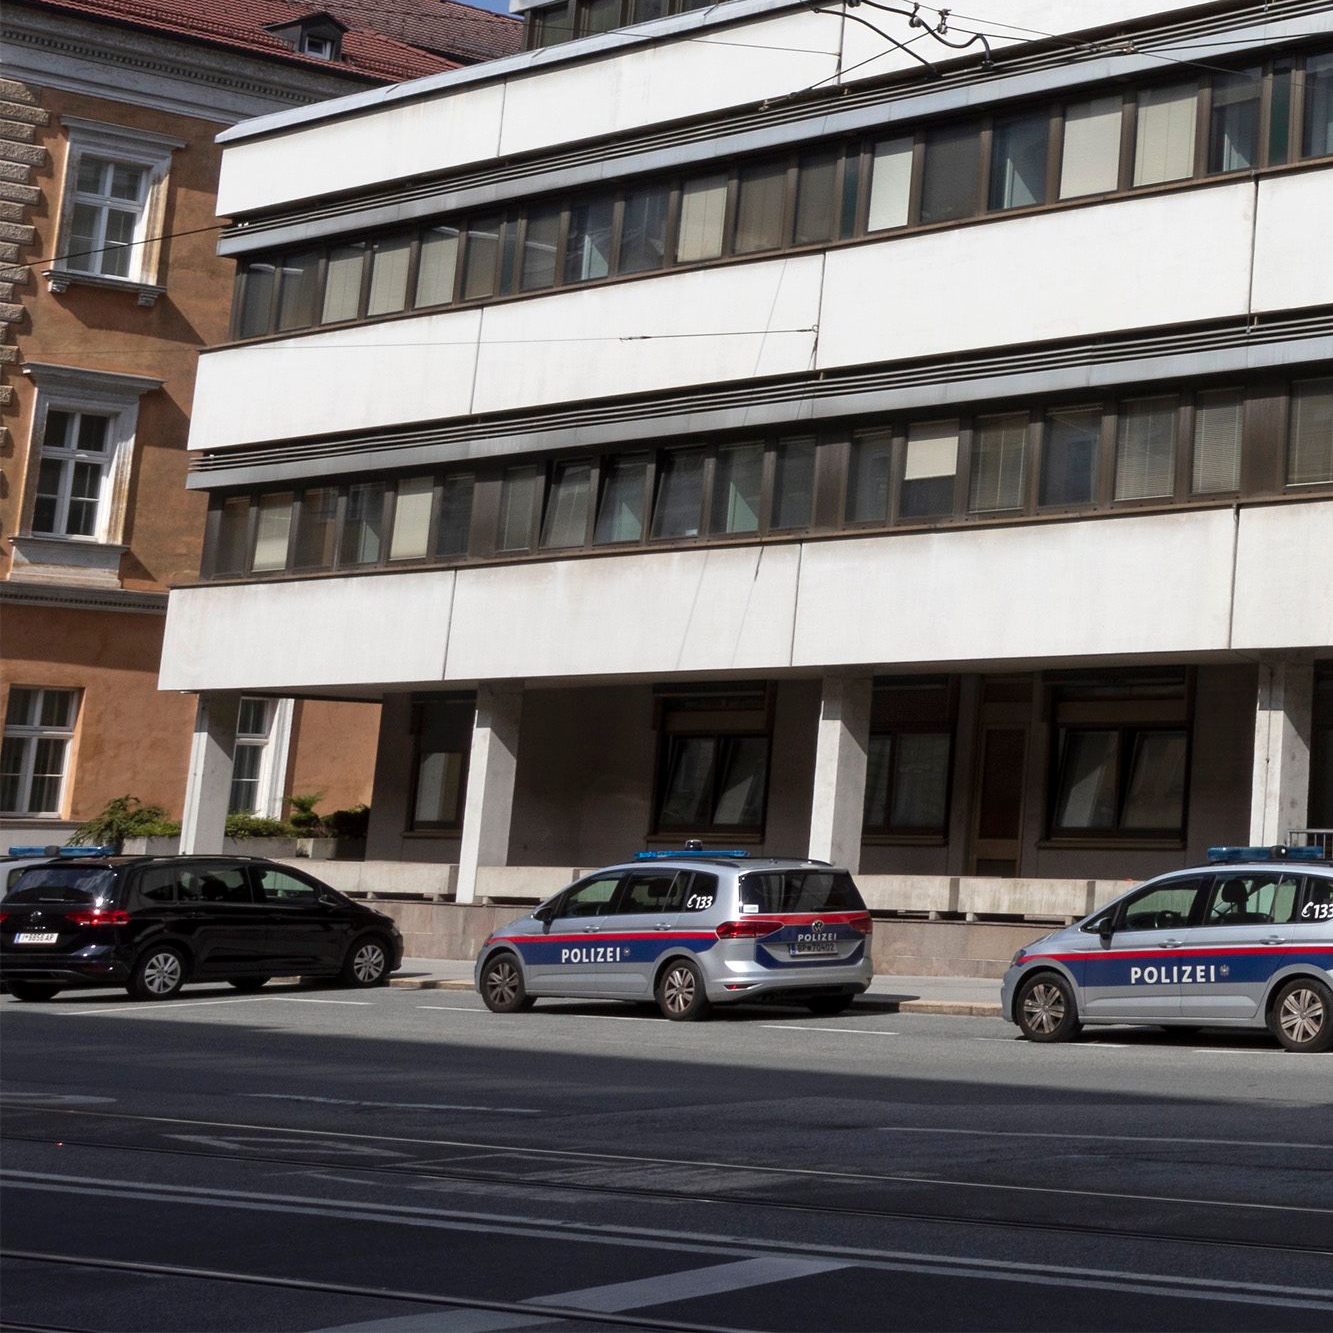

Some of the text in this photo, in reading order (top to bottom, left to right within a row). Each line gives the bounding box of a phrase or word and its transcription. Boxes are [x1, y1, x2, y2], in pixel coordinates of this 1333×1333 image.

[695, 895, 713, 909] 133
[797, 932, 838, 942] POLIZEI
[561, 947, 621, 964] POLIZEI
[1130, 965, 1215, 984] POLIZEI
